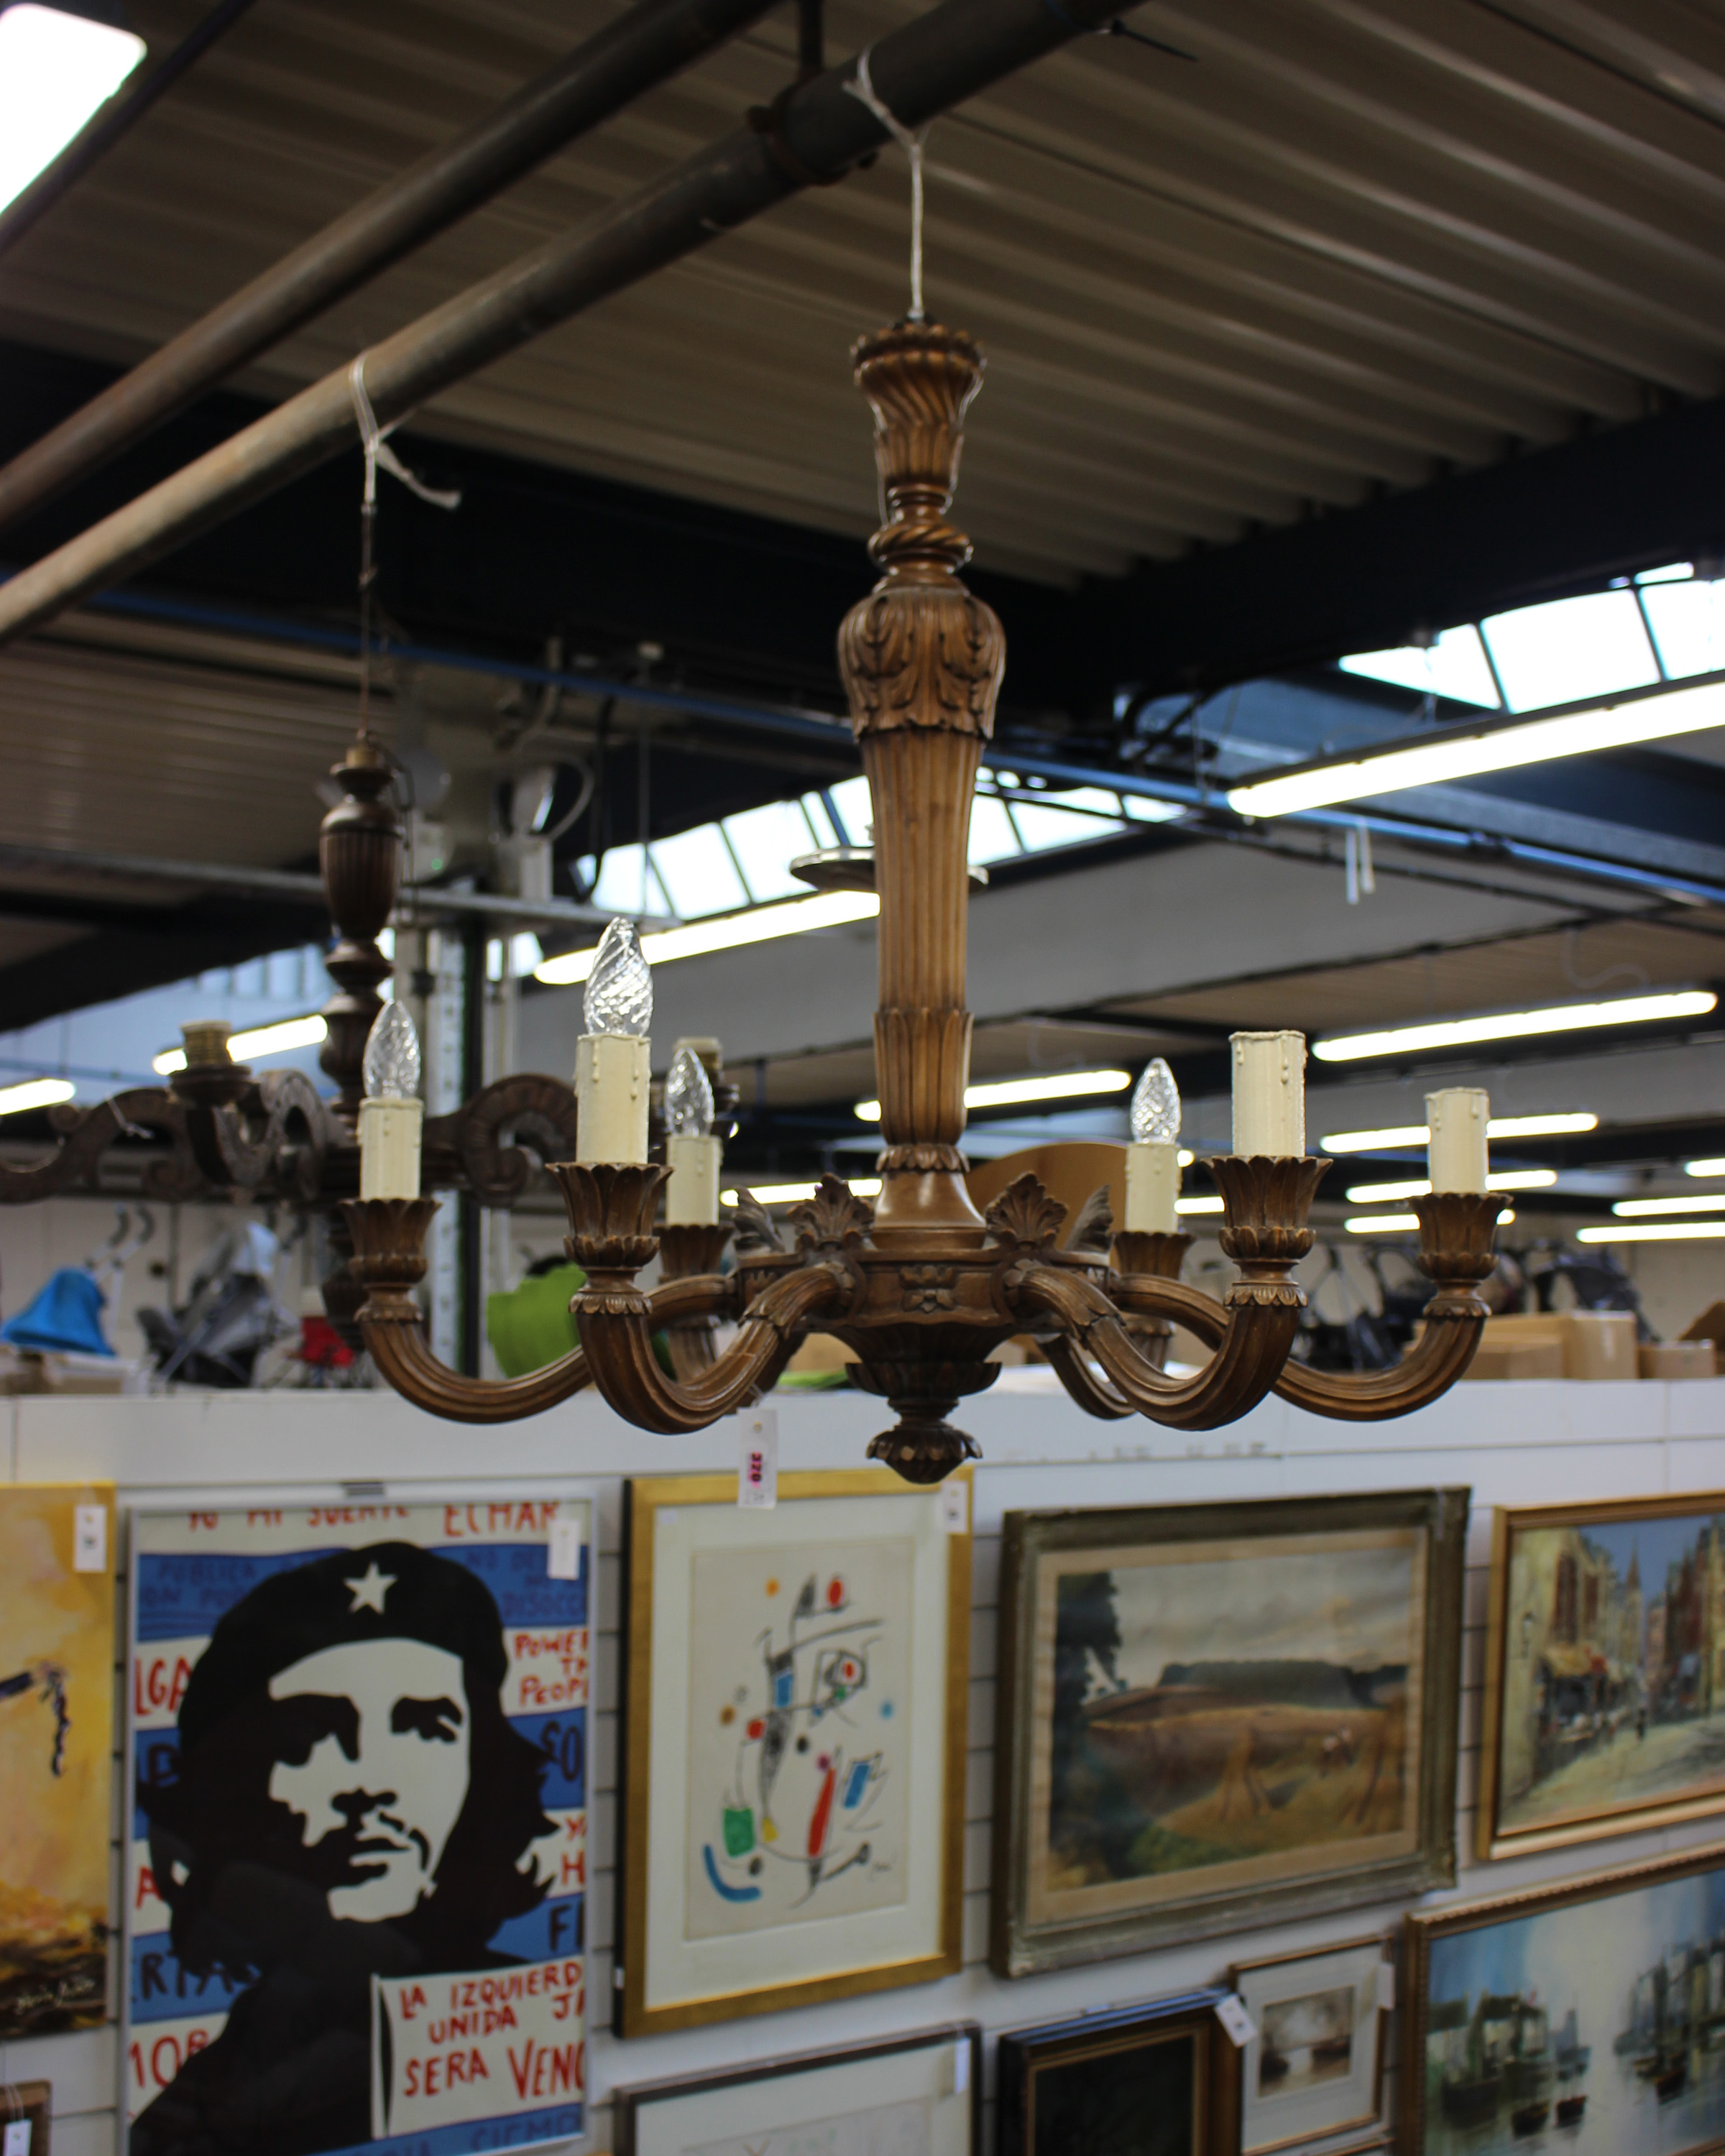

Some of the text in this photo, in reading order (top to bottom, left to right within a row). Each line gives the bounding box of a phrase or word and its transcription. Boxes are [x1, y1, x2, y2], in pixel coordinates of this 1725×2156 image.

[400, 1986, 426, 2021] LA
[428, 2004, 517, 2045] UNIDA
[403, 2047, 489, 2096] SERA
